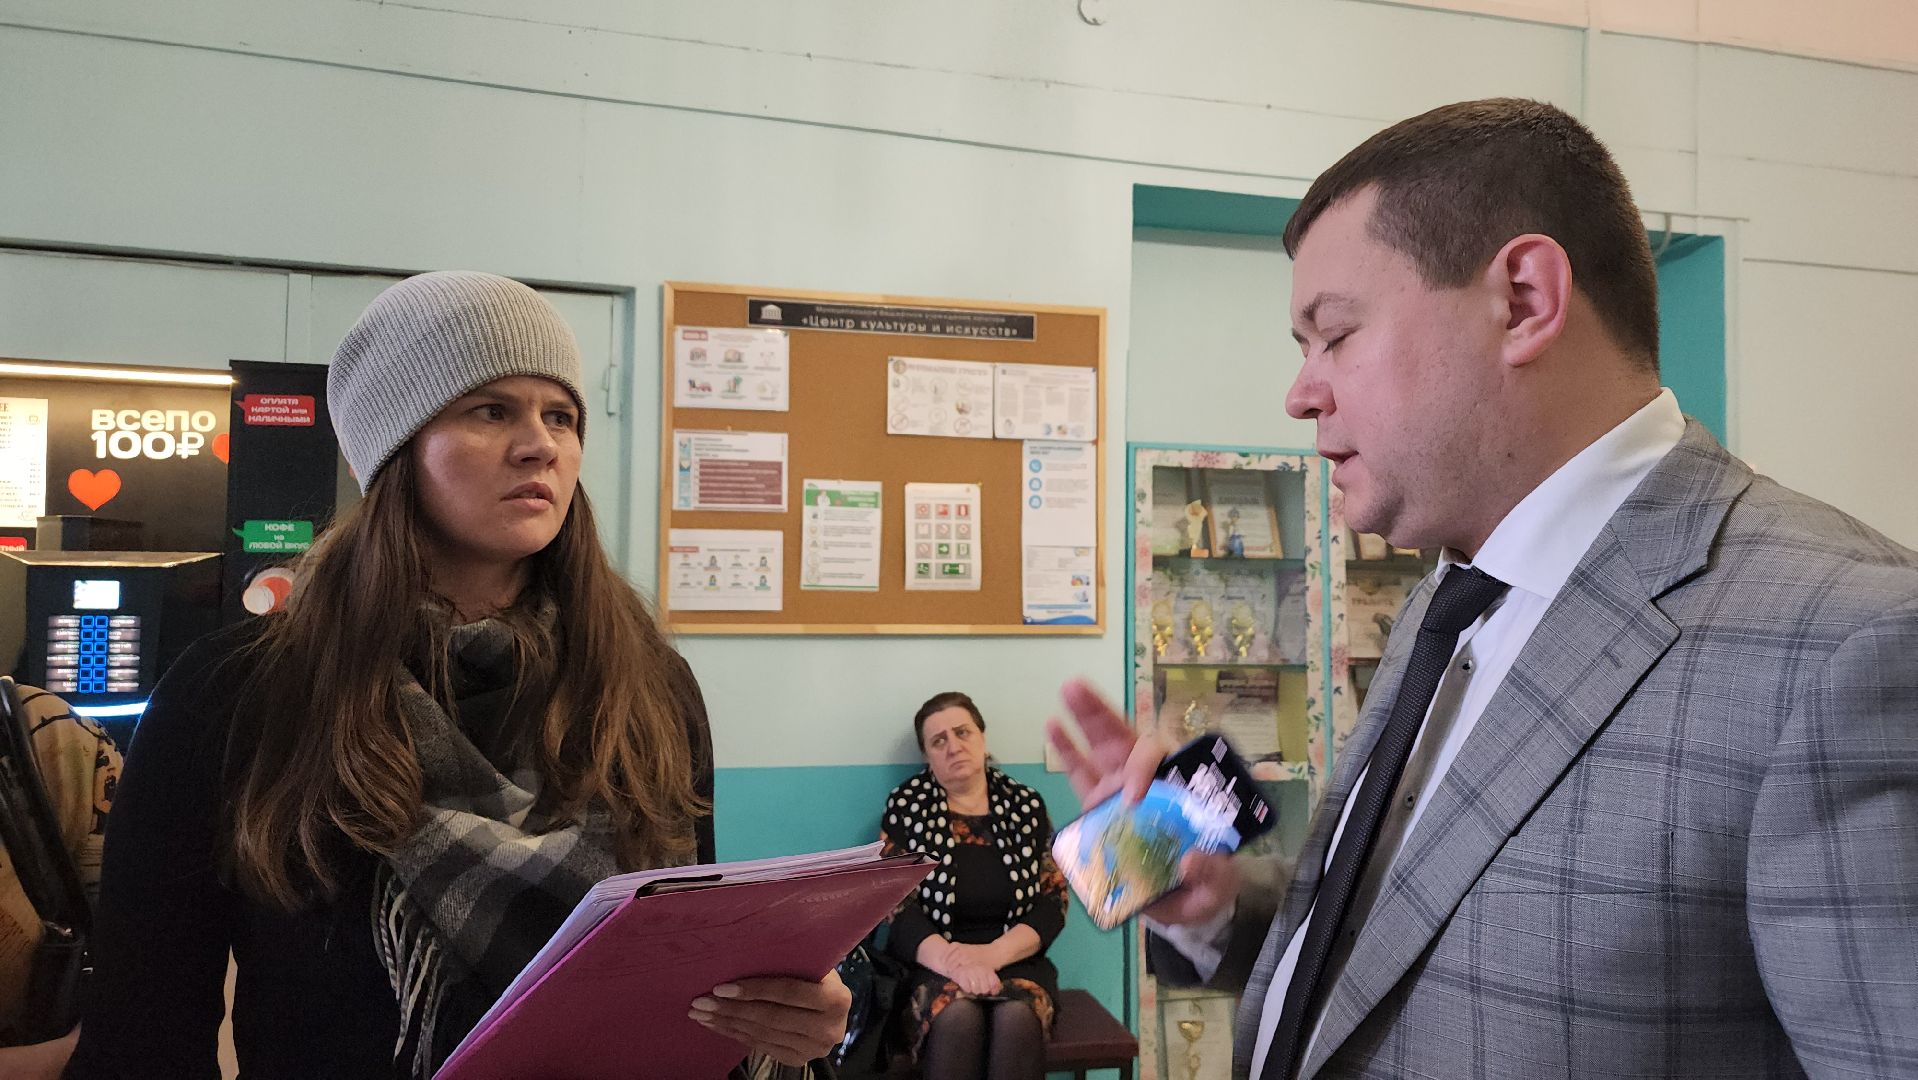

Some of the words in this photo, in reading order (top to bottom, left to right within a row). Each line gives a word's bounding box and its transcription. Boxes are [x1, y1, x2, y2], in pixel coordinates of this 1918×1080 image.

[802, 314, 855, 329] «Центр
[860, 319, 927, 334] культуры
[932, 323, 941, 333] и
[91, 429, 205, 460] 100₽
